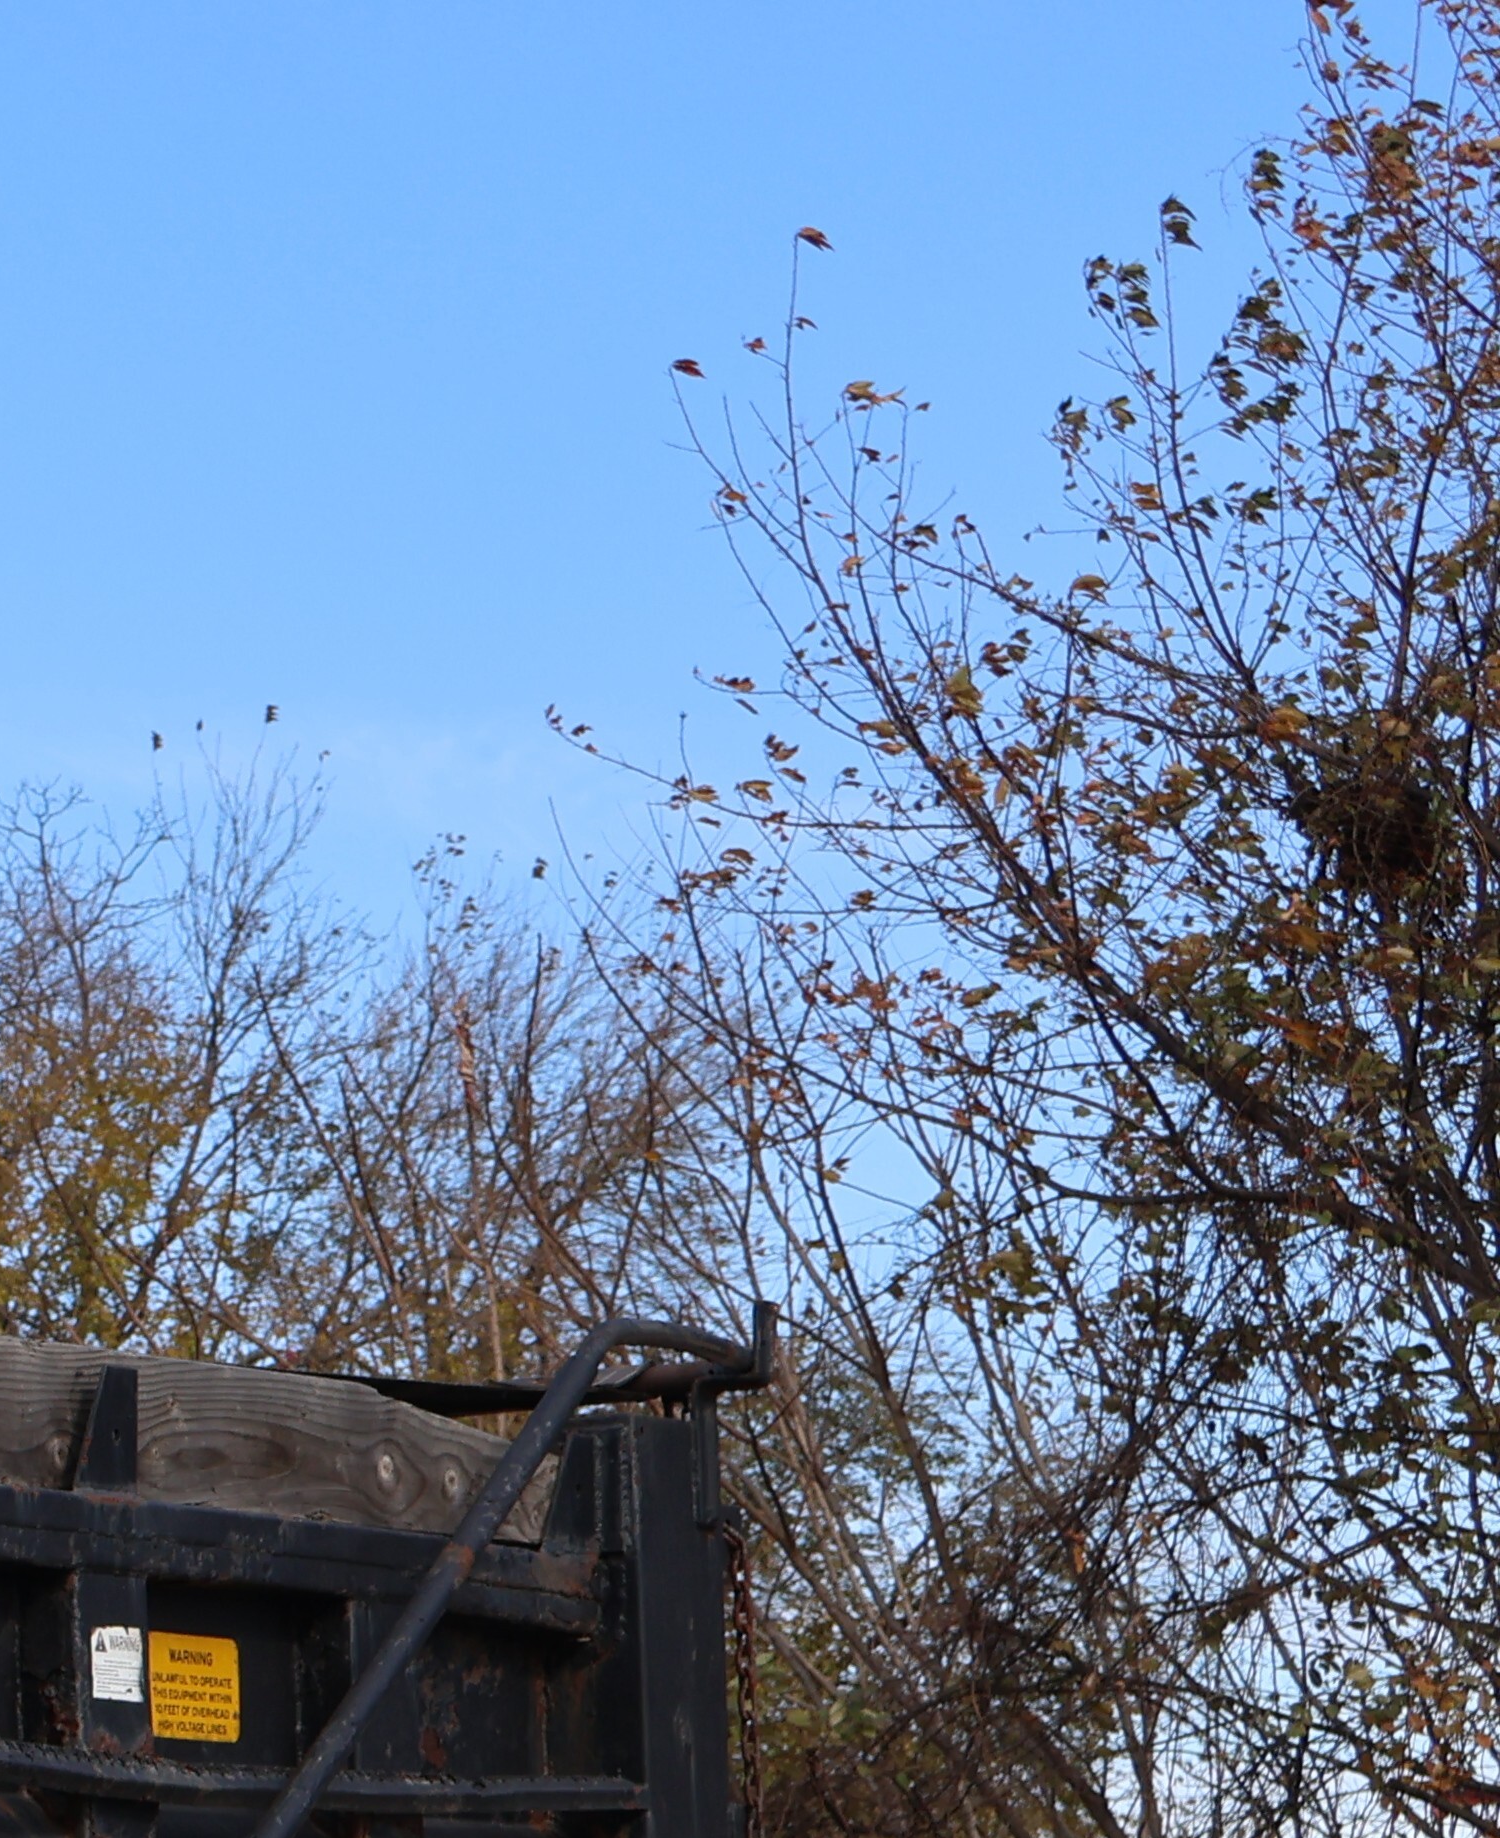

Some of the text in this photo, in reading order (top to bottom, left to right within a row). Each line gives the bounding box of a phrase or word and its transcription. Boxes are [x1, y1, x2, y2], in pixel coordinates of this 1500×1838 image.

[169, 1648, 213, 1667] WARNING
[153, 1672, 232, 1689] UNLAWFUL TO OPERATE
[153, 1686, 232, 1704] THIS EQUIPMENT WITHIN
[163, 1704, 180, 1715] FEET
[181, 1706, 190, 1716] OF
[192, 1707, 230, 1719] OVERHEAD
[176, 1721, 205, 1733] VOLTAGE
[206, 1723, 227, 1735] LINES
